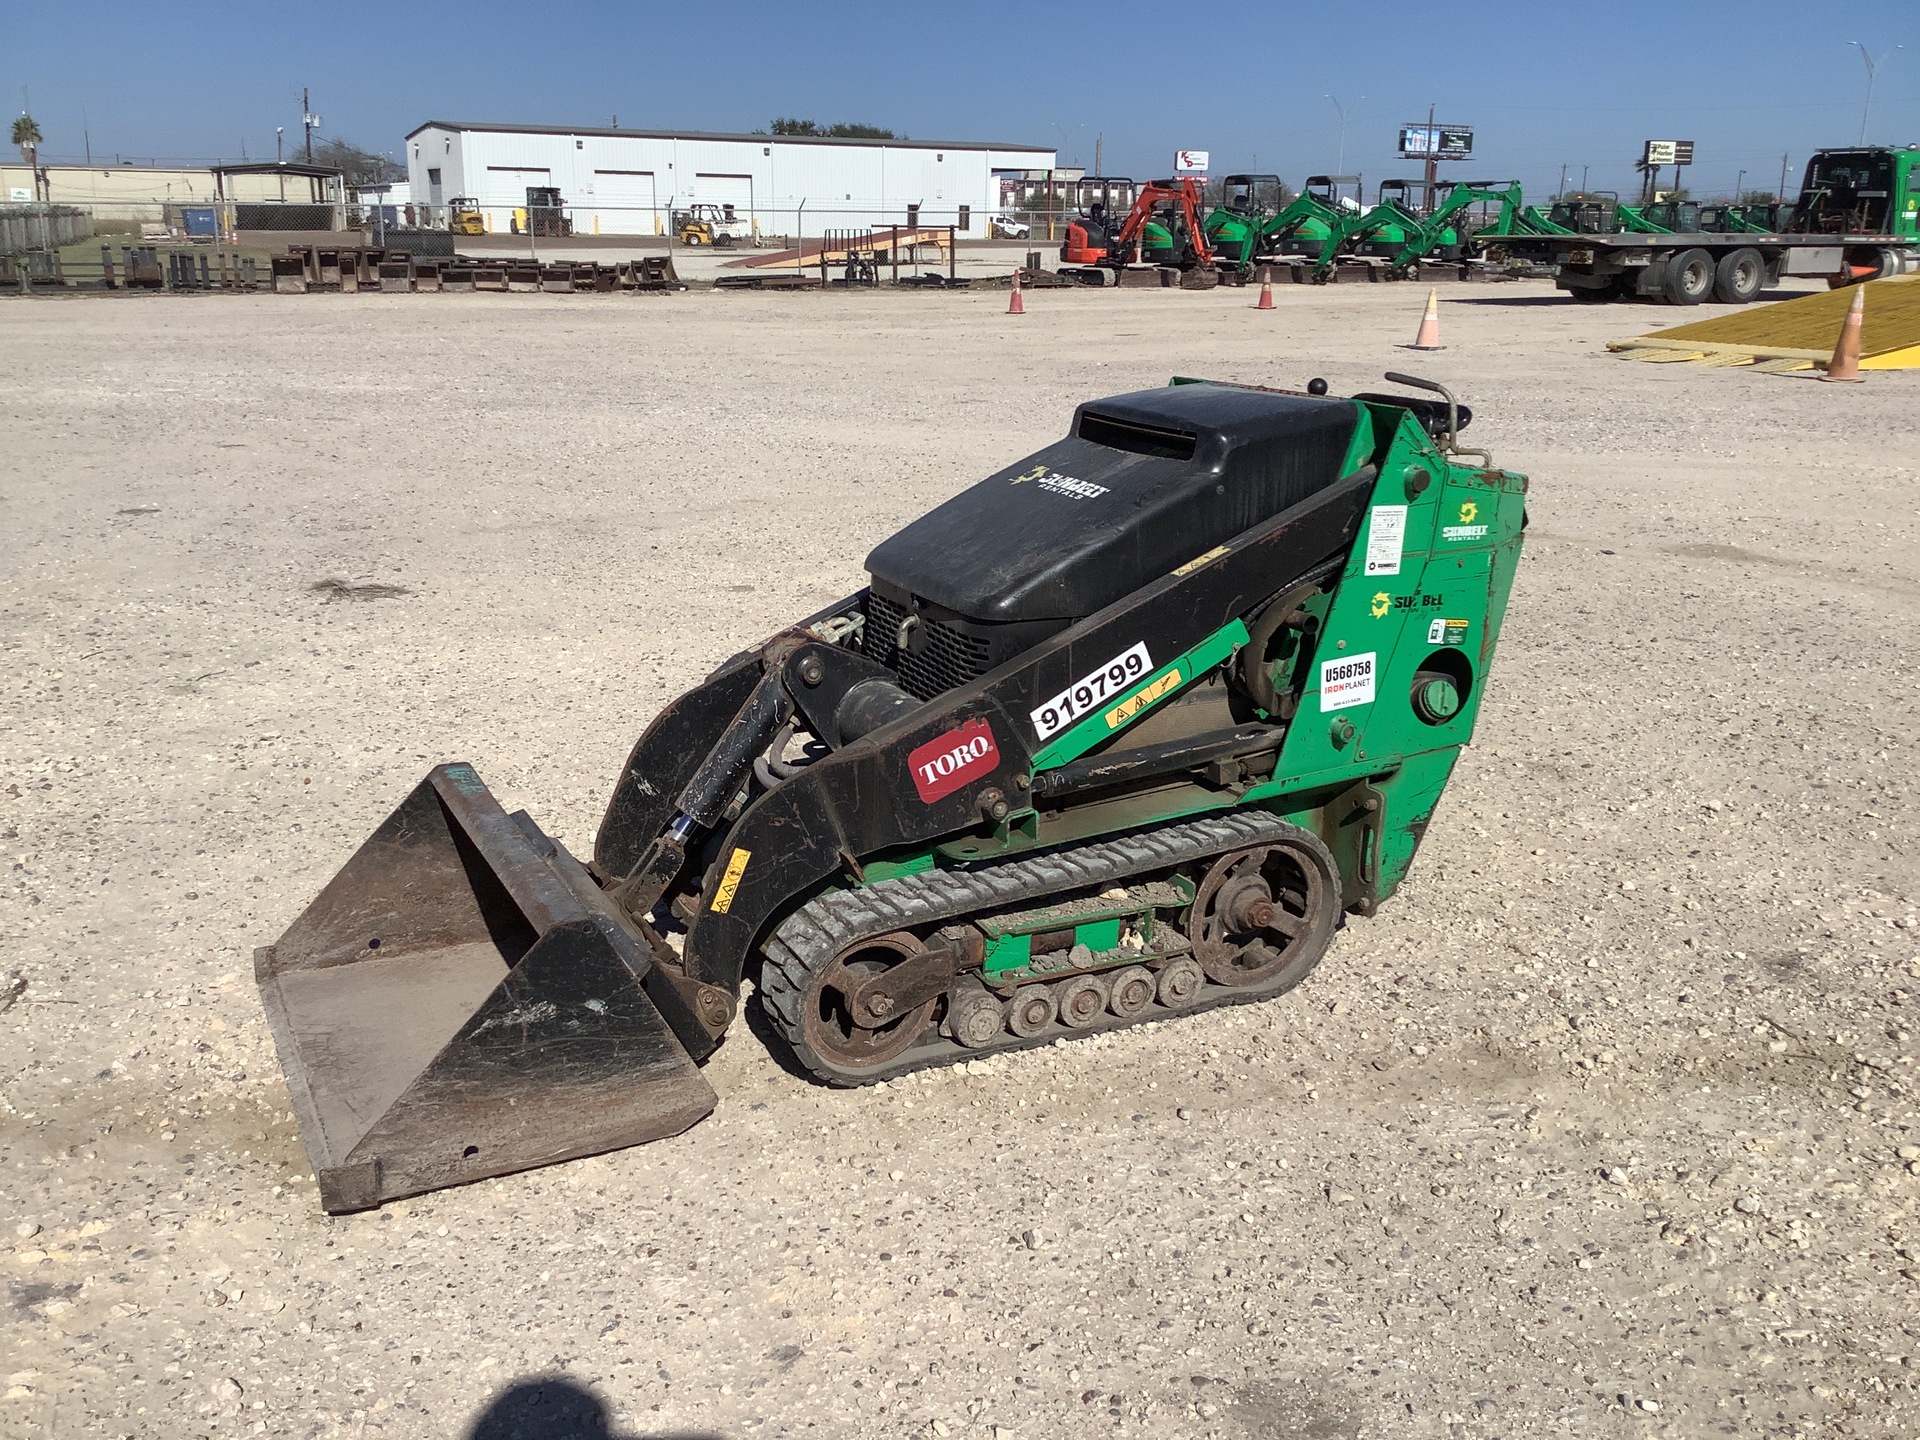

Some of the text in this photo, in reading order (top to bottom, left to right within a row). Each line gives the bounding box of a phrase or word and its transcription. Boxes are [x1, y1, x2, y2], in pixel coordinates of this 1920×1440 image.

[1442, 525, 1488, 537] SUNBELT
[1325, 661, 1371, 682] U568758
[1040, 653, 1142, 730] 919799
[1324, 678, 1371, 694] IRONPLANET
[918, 736, 988, 785] TORO
